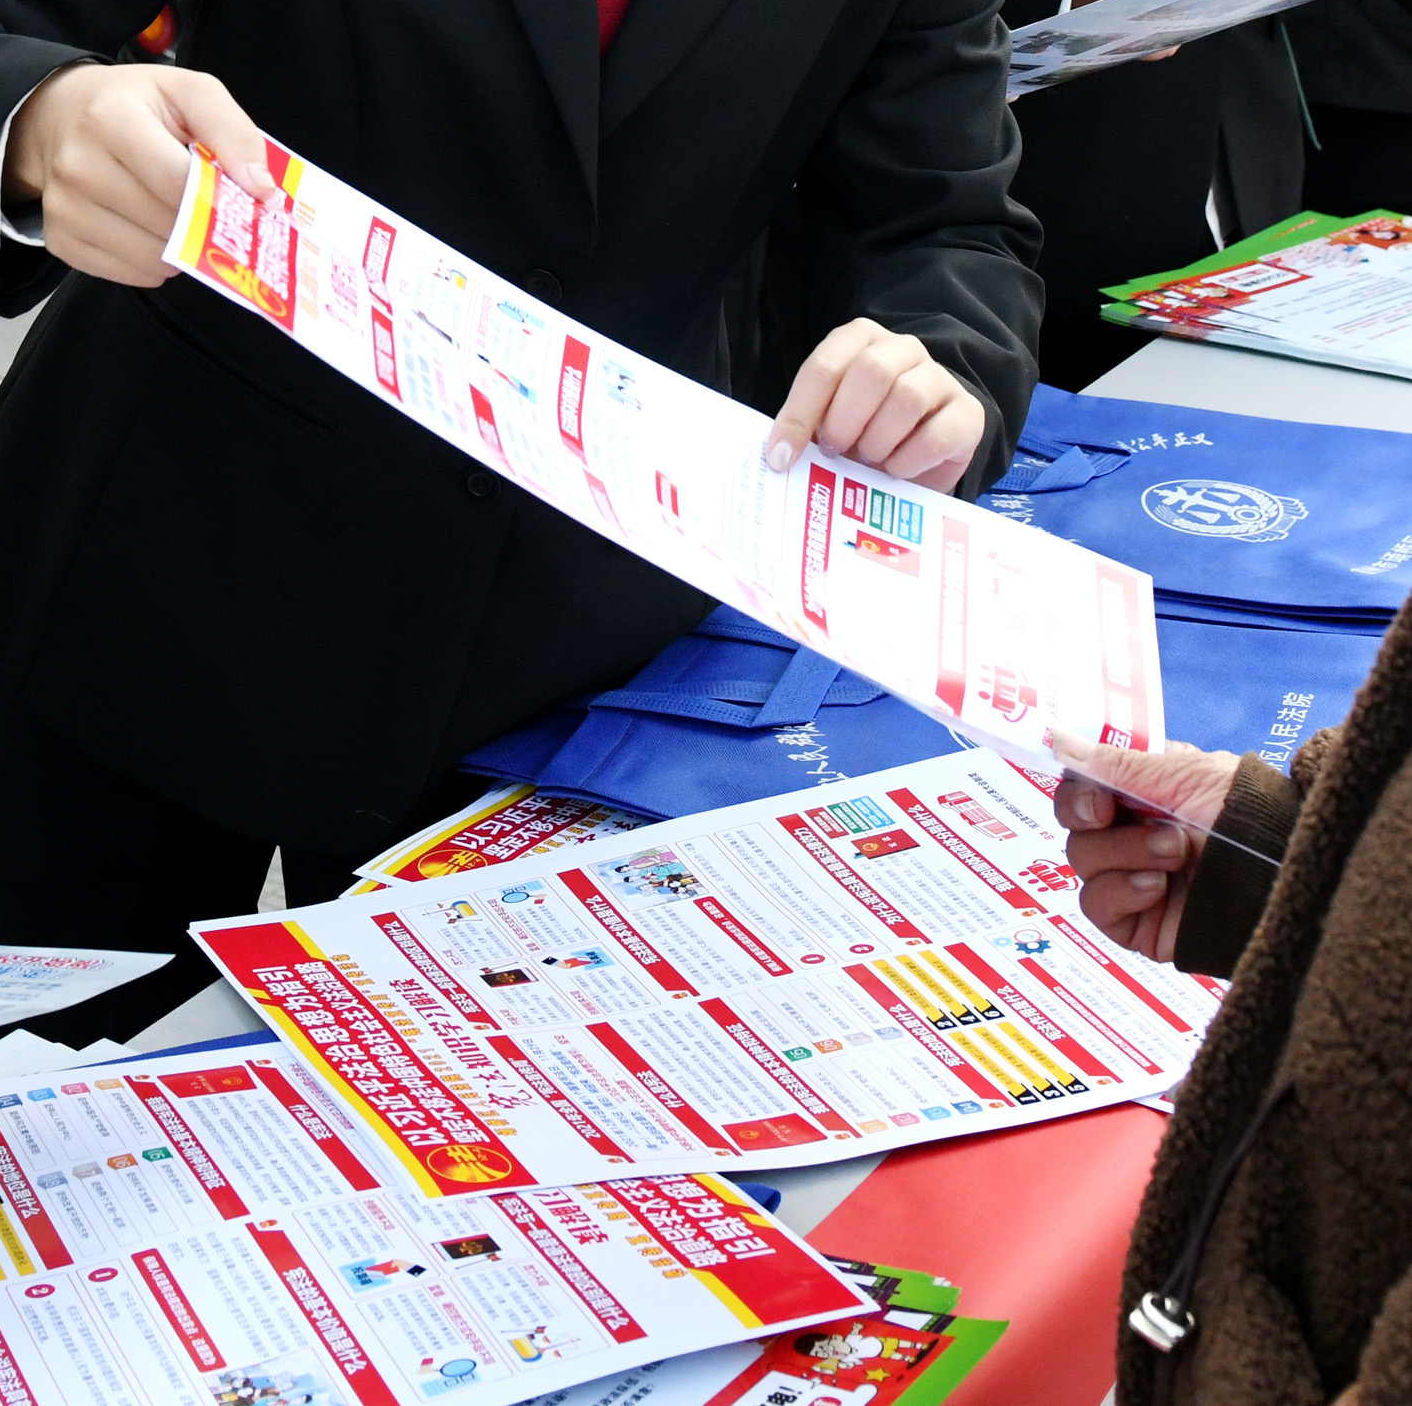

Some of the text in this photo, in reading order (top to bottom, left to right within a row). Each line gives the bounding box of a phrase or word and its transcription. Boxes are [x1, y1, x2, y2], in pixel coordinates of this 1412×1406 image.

[792, 826, 905, 924] 为什么说宪法具有最高法律效力
[905, 803, 1017, 892] 我国的国体和政体分别是什么
[380, 920, 482, 1014] 宪法与一般普通法律的区别是什么
[581, 893, 662, 965] 宪法的基本价值是什么
[251, 962, 451, 1149] 以习近平法治思想为指引
[291, 958, 491, 1146] 坚定不移走中国特色社会主义法治道路
[386, 975, 539, 1112] 宪法知识学习解读
[817, 1039, 839, 1051] 06
[885, 1002, 966, 1066] 宪法的地位是什么
[993, 984, 1068, 1040] 宪法作用是什么
[633, 1069, 685, 1108] 什么是宪法
[724, 1021, 831, 1114] 我国宪法的基本精神和特征
[110, 1155, 133, 1168] 06
[142, 1095, 226, 1190] 我国宪法的基本精神和特征
[286, 1102, 335, 1141] 什么是宪法
[495, 1195, 634, 1331] 宪法与一般普通法律的区别是什么
[280, 1266, 372, 1376] 宪法的基本价值是什么
